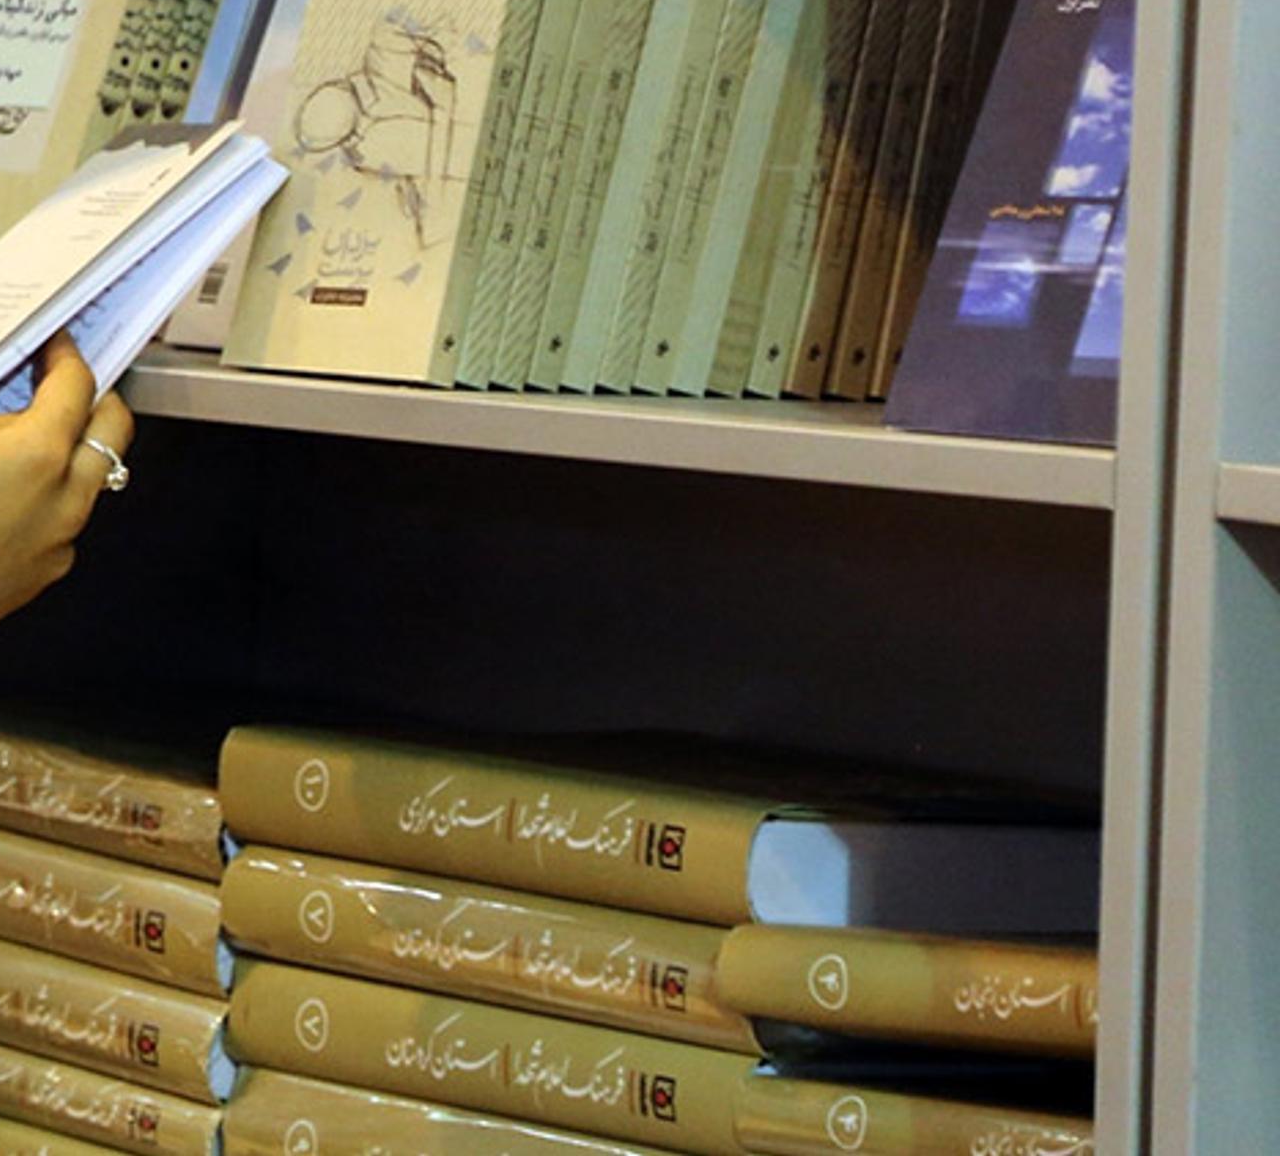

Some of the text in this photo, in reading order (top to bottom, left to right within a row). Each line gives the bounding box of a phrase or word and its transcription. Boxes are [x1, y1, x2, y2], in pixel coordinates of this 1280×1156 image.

[398, 776, 454, 834] مرکزی
[433, 796, 506, 838] استان
[517, 793, 551, 840] شهدا
[567, 800, 635, 858] فرهنگ
[393, 900, 472, 963] کردستان
[440, 928, 511, 971] استان
[573, 937, 638, 996] فرهنگ
[954, 976, 1000, 1019] زنجان
[996, 976, 1071, 1018] استان
[385, 1012, 463, 1072] کردستان
[434, 1039, 501, 1079] استان
[513, 1039, 544, 1085] شهدا
[564, 1048, 625, 1105] فرهنگ
